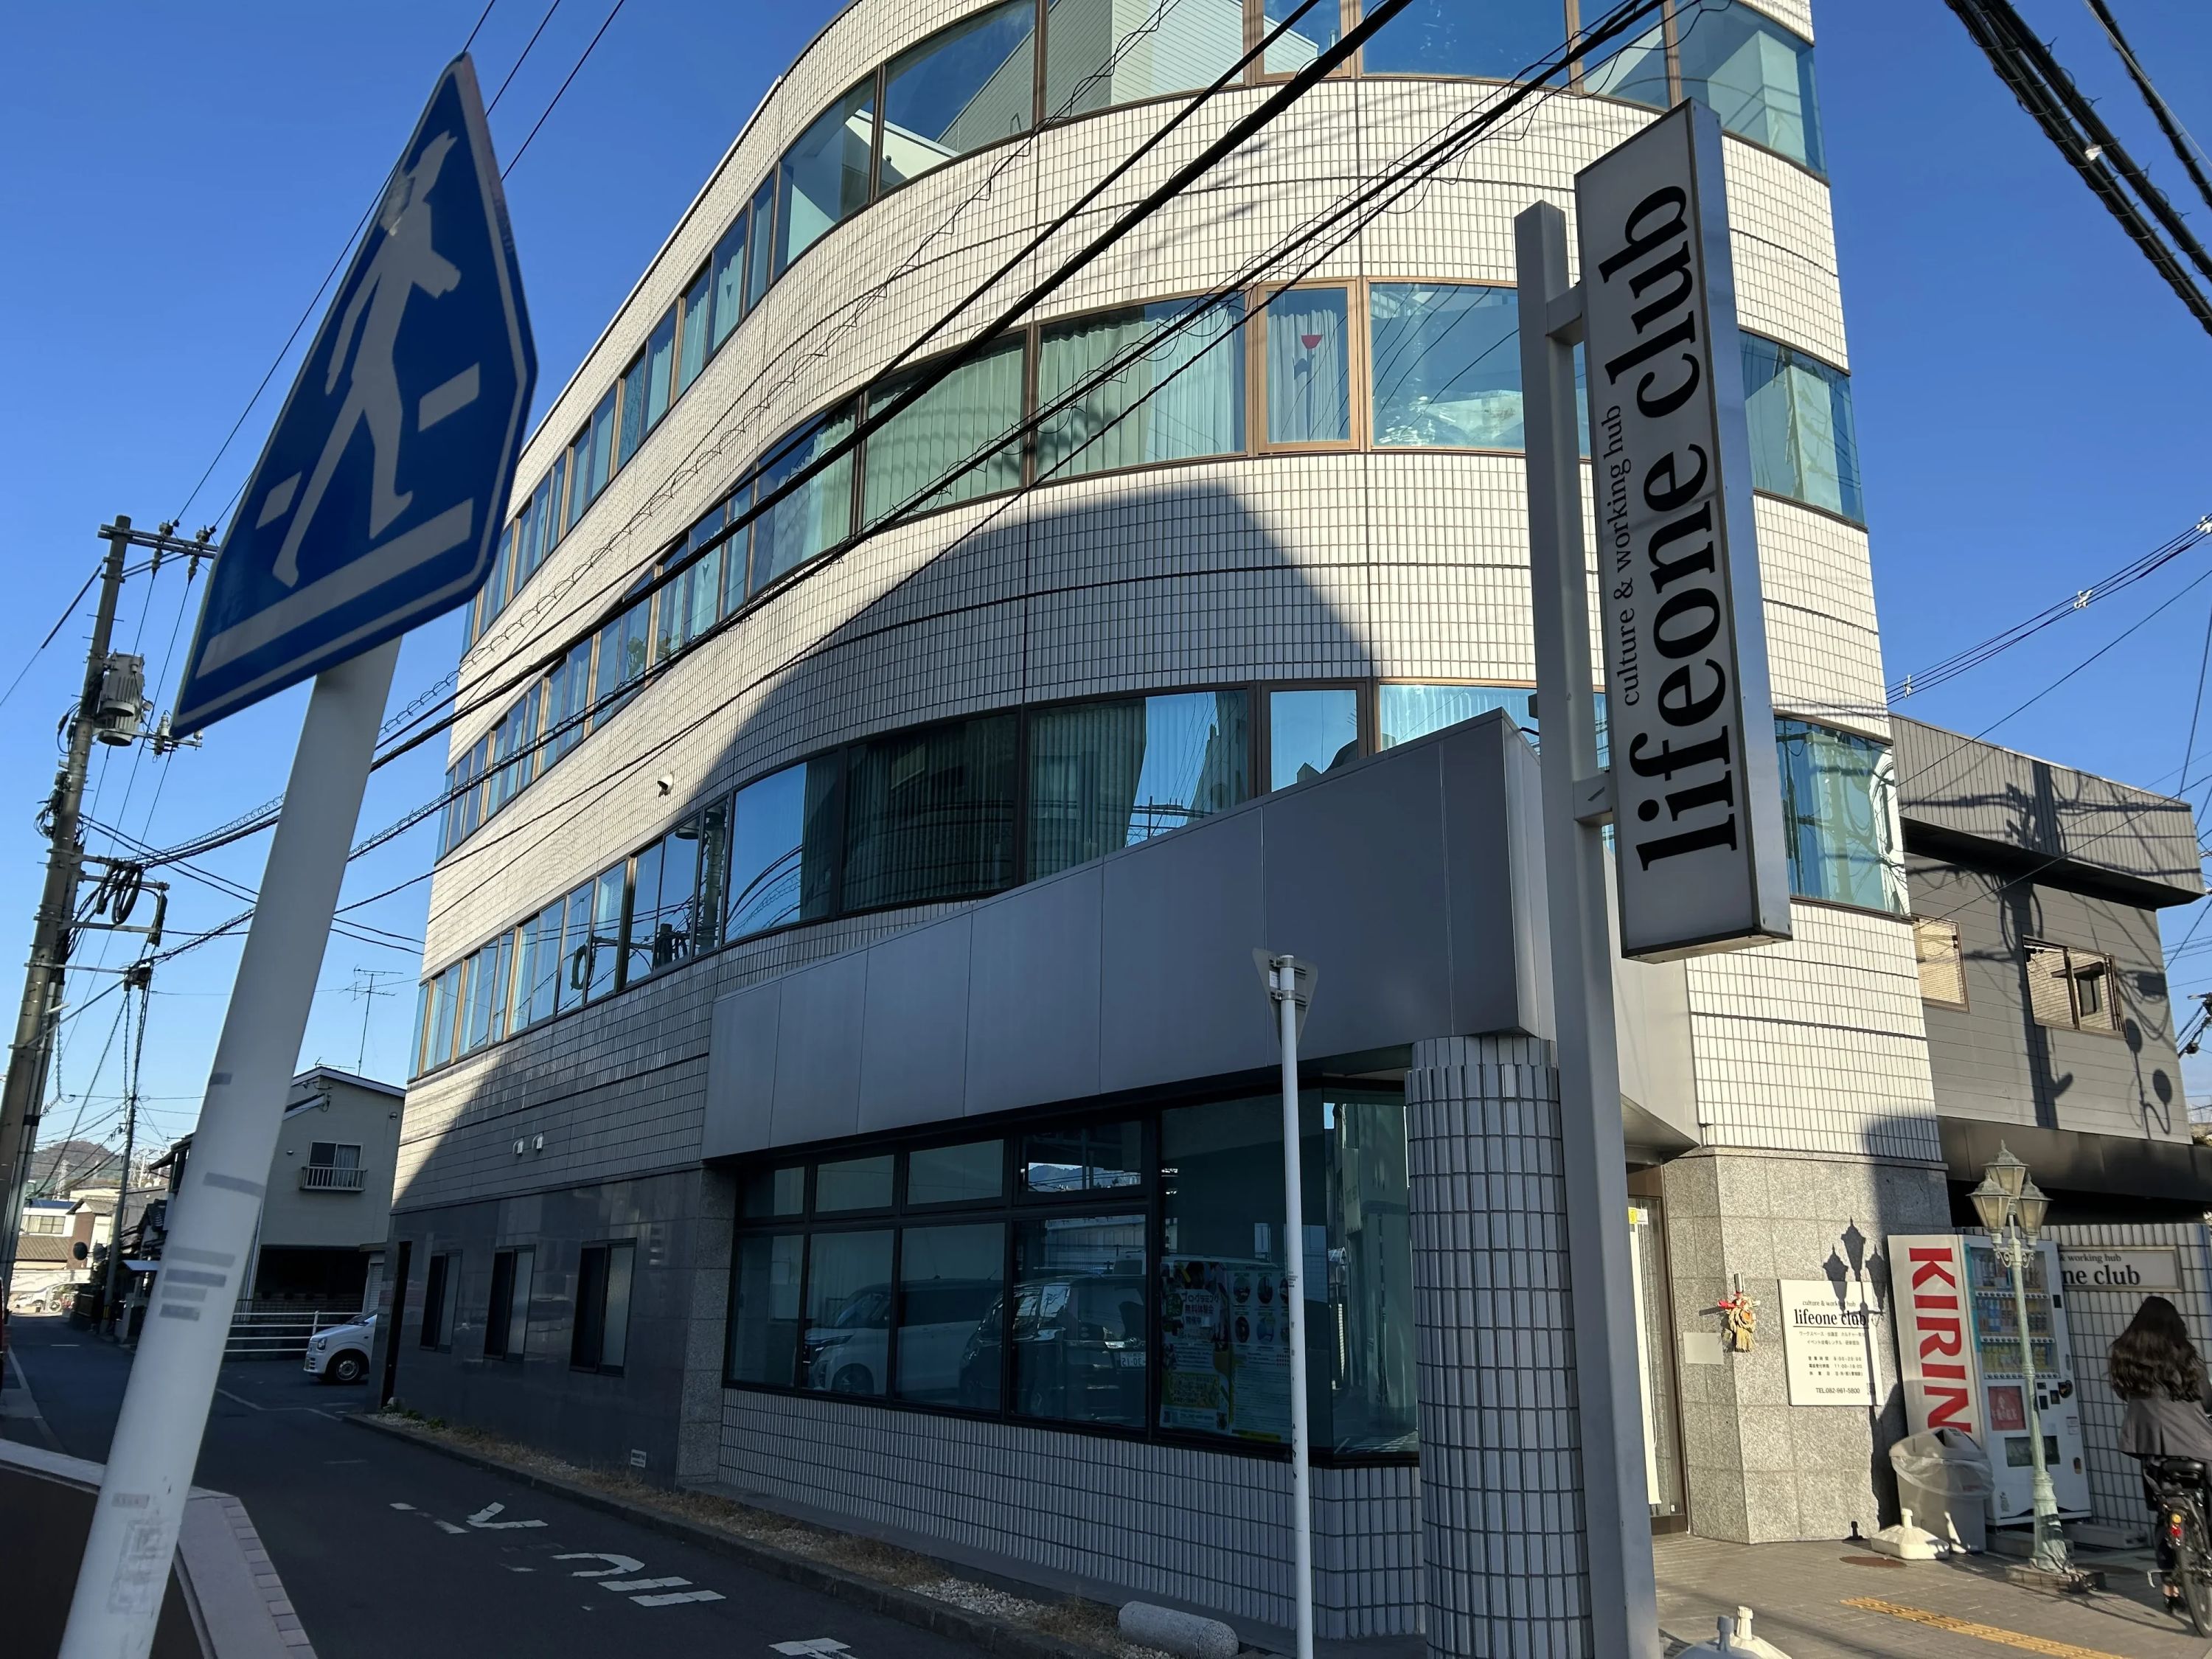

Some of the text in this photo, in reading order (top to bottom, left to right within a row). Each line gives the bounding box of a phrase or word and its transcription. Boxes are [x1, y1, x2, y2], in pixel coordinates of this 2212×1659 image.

[1598, 184, 1739, 872] lifeone club
[1601, 405, 1639, 706] culture & working hub
[2067, 1253, 2103, 1264] working
[2104, 1253, 2122, 1262] hub
[2093, 1265, 2141, 1285] club
[1793, 1308, 1867, 1326] lifeone club
[1908, 1247, 1973, 1434] KIRIN
